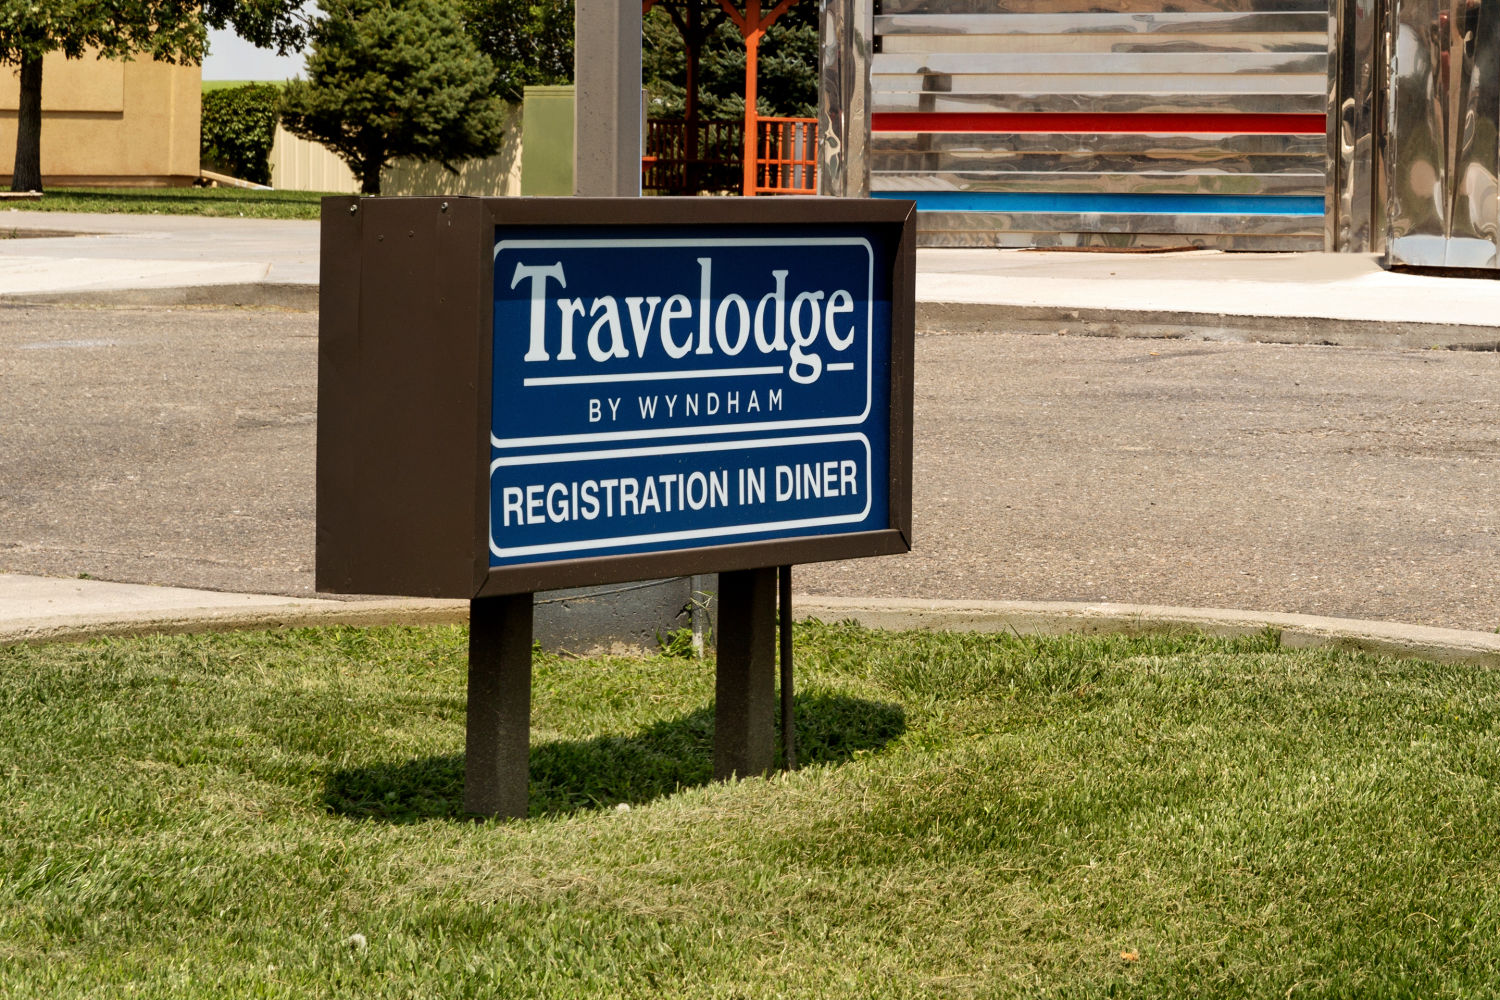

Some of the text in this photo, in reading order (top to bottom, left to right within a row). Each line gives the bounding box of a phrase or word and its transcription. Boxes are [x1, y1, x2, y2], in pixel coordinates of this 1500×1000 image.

[510, 257, 855, 385] Travelodge
[589, 389, 783, 423] BY WYNDHAM
[503, 460, 858, 527] REGISTRATION IN DINER
